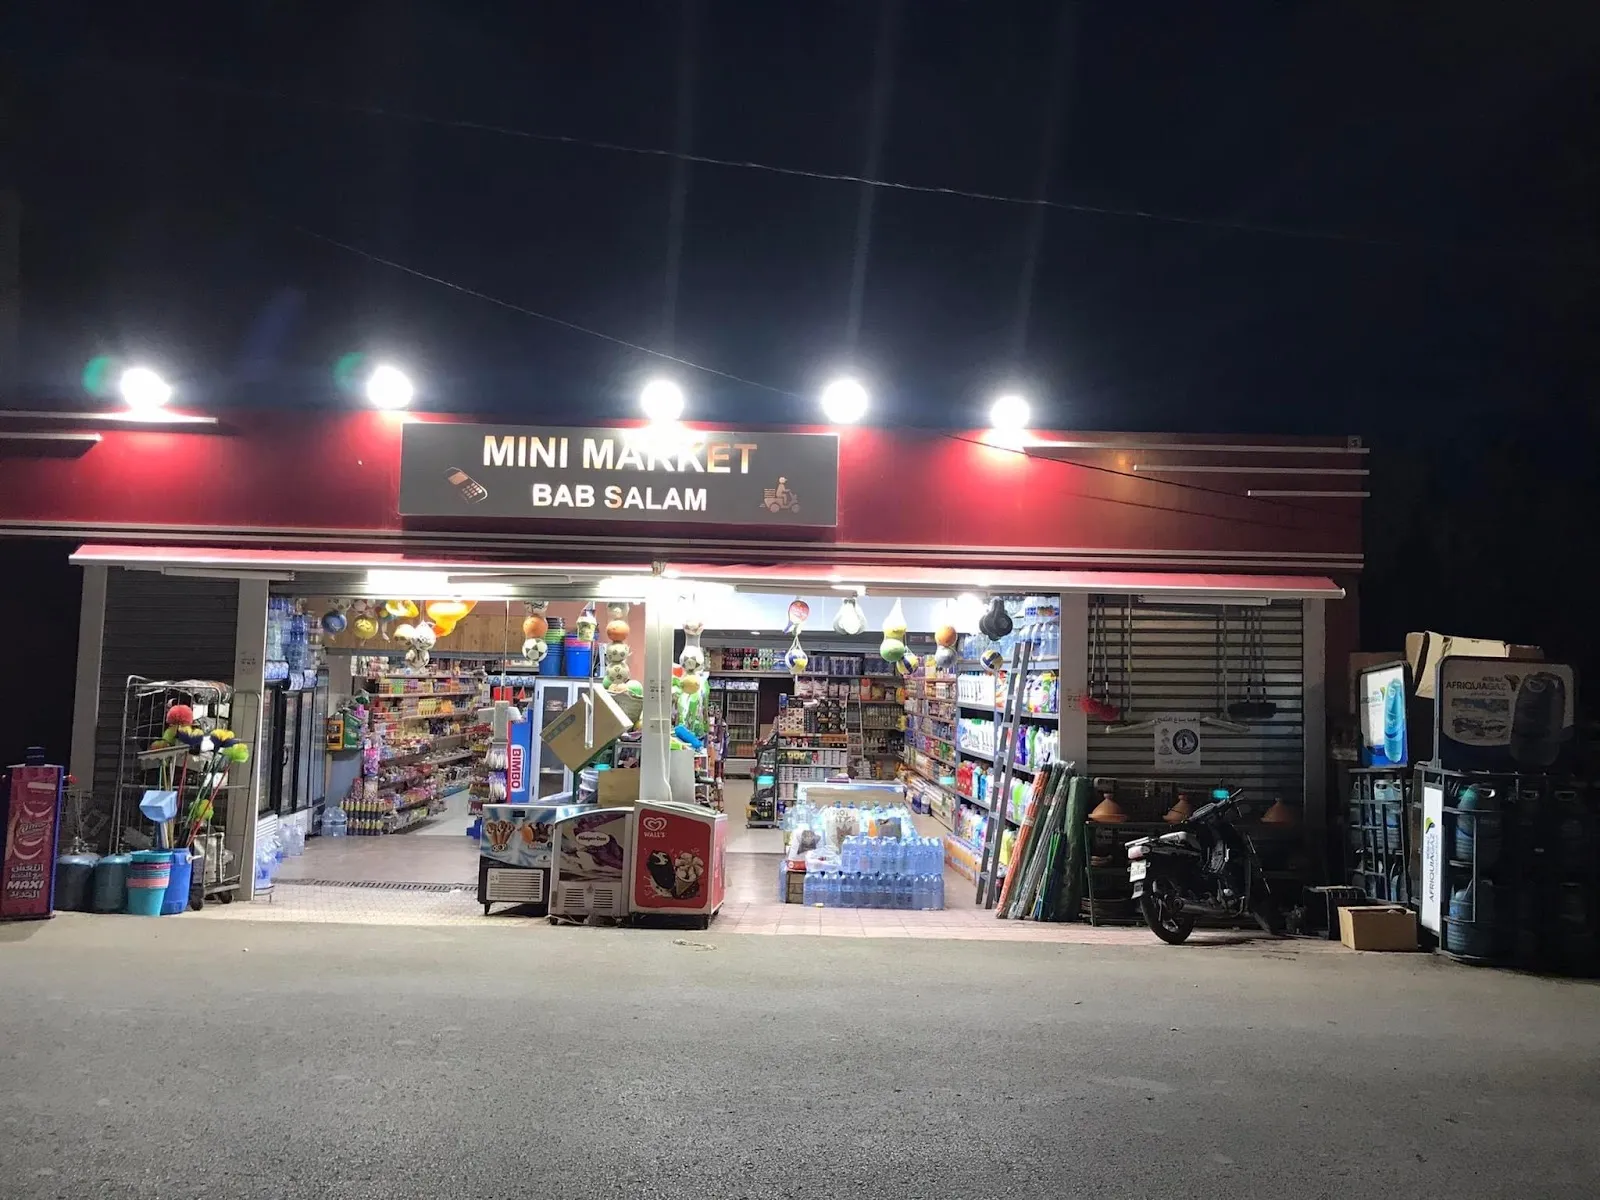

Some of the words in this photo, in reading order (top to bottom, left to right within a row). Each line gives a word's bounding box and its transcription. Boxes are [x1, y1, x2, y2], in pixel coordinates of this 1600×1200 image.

[482, 435, 569, 468] MINI
[582, 438, 758, 475] MARKET
[532, 483, 596, 508] BAB
[604, 485, 708, 512] SALAM
[511, 748, 521, 789] BIMBO
[6, 880, 45, 890] MAXI
